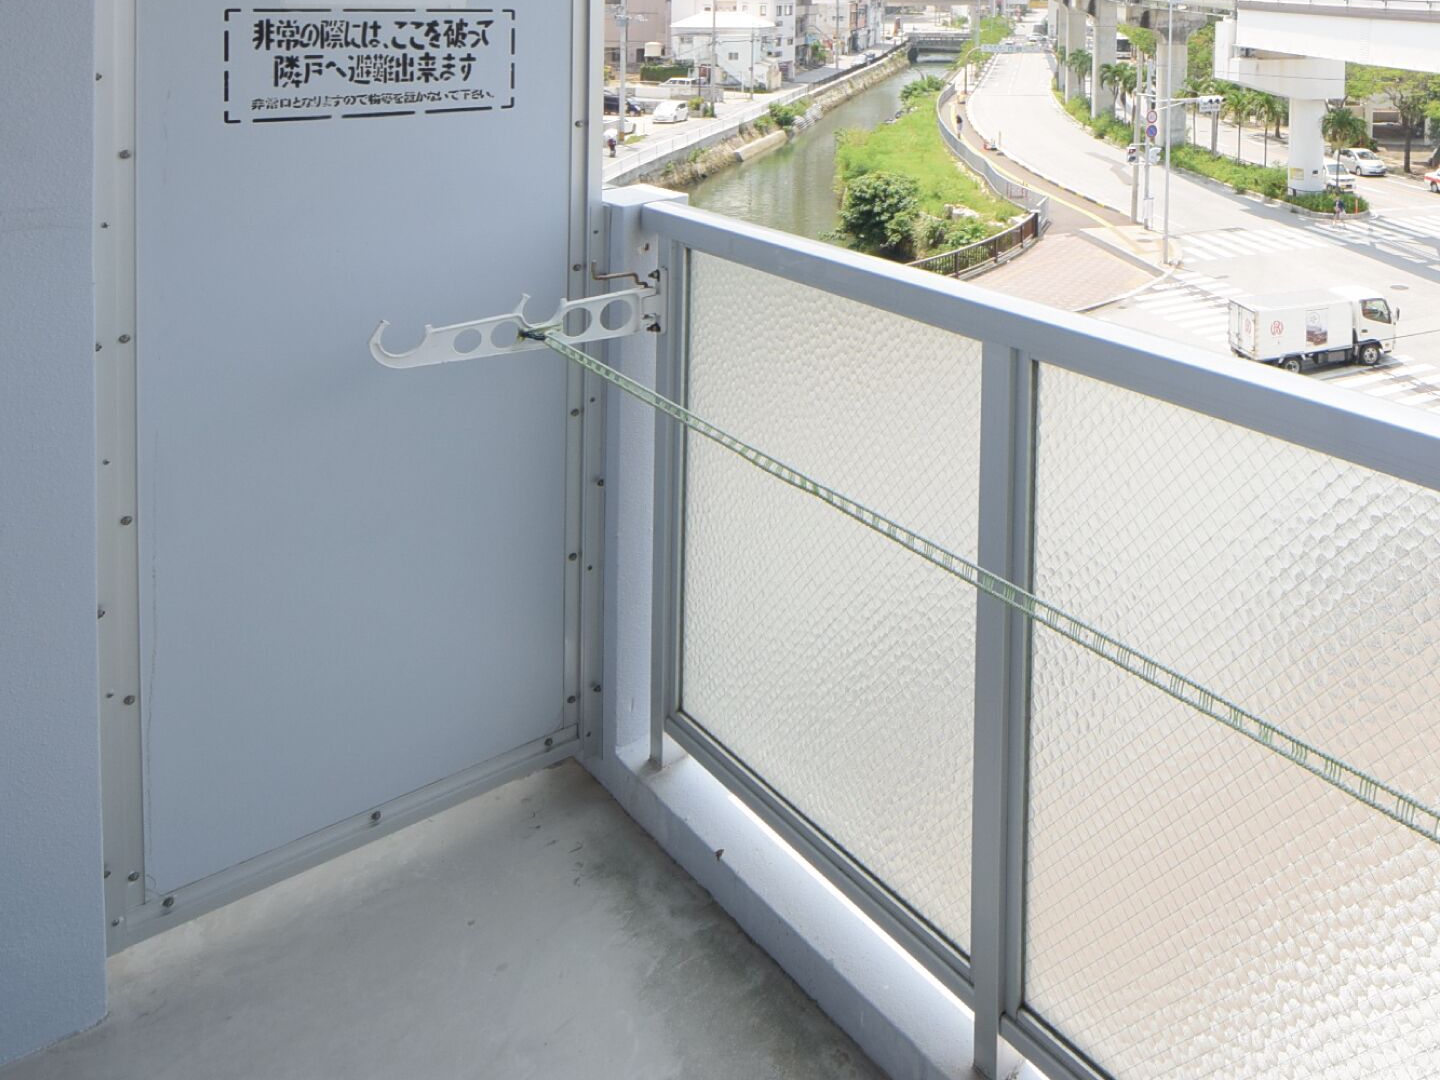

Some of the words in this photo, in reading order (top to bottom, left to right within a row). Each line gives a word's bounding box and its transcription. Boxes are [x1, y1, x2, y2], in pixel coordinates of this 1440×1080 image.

[252, 18, 495, 51] 非常の際には、ここを破って
[273, 51, 478, 89] 隣戸へ避難出来ます
